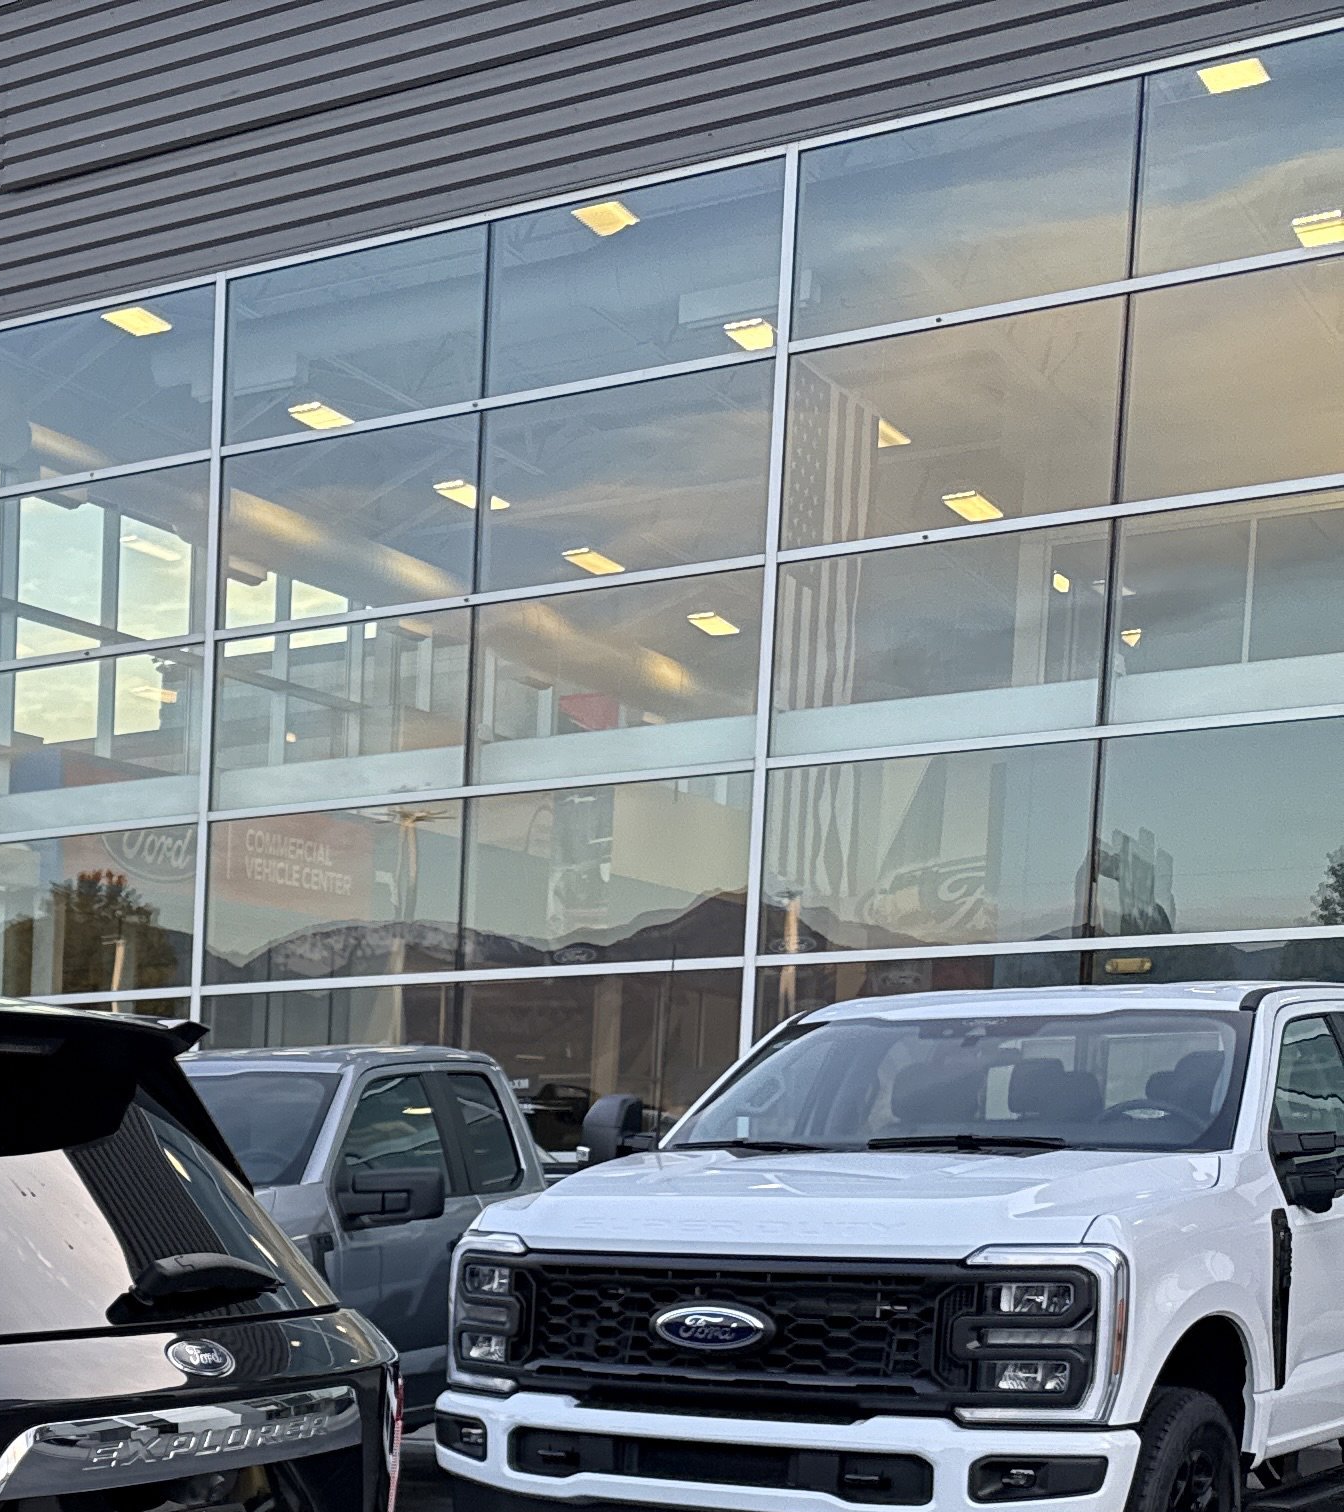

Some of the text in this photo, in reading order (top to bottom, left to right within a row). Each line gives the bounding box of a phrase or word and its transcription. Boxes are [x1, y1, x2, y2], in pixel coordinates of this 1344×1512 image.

[245, 829, 333, 866] COMMERCIAL
[245, 857, 351, 895] VEHICLE CENTER
[679, 1314, 738, 1340] Ford
[184, 1344, 223, 1365] Ford
[82, 1415, 329, 1471] EXPLORER
